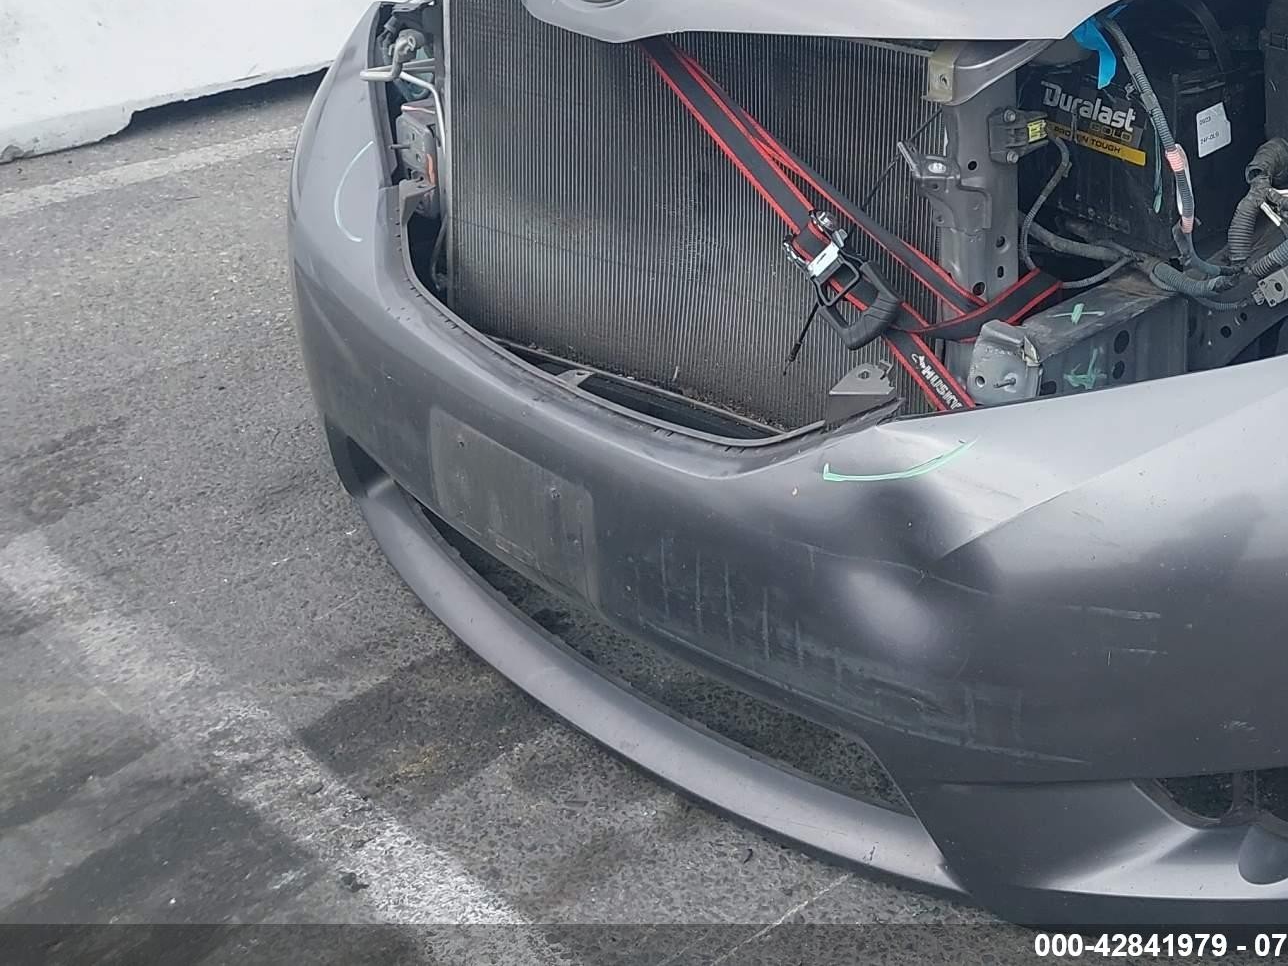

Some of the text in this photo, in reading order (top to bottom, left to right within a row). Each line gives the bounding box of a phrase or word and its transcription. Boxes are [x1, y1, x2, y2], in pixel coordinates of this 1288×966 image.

[1041, 80, 1136, 133] Duralast
[1089, 120, 1133, 143] GOLD
[1091, 137, 1121, 154] TOUGH
[921, 364, 963, 410] HUSKY
